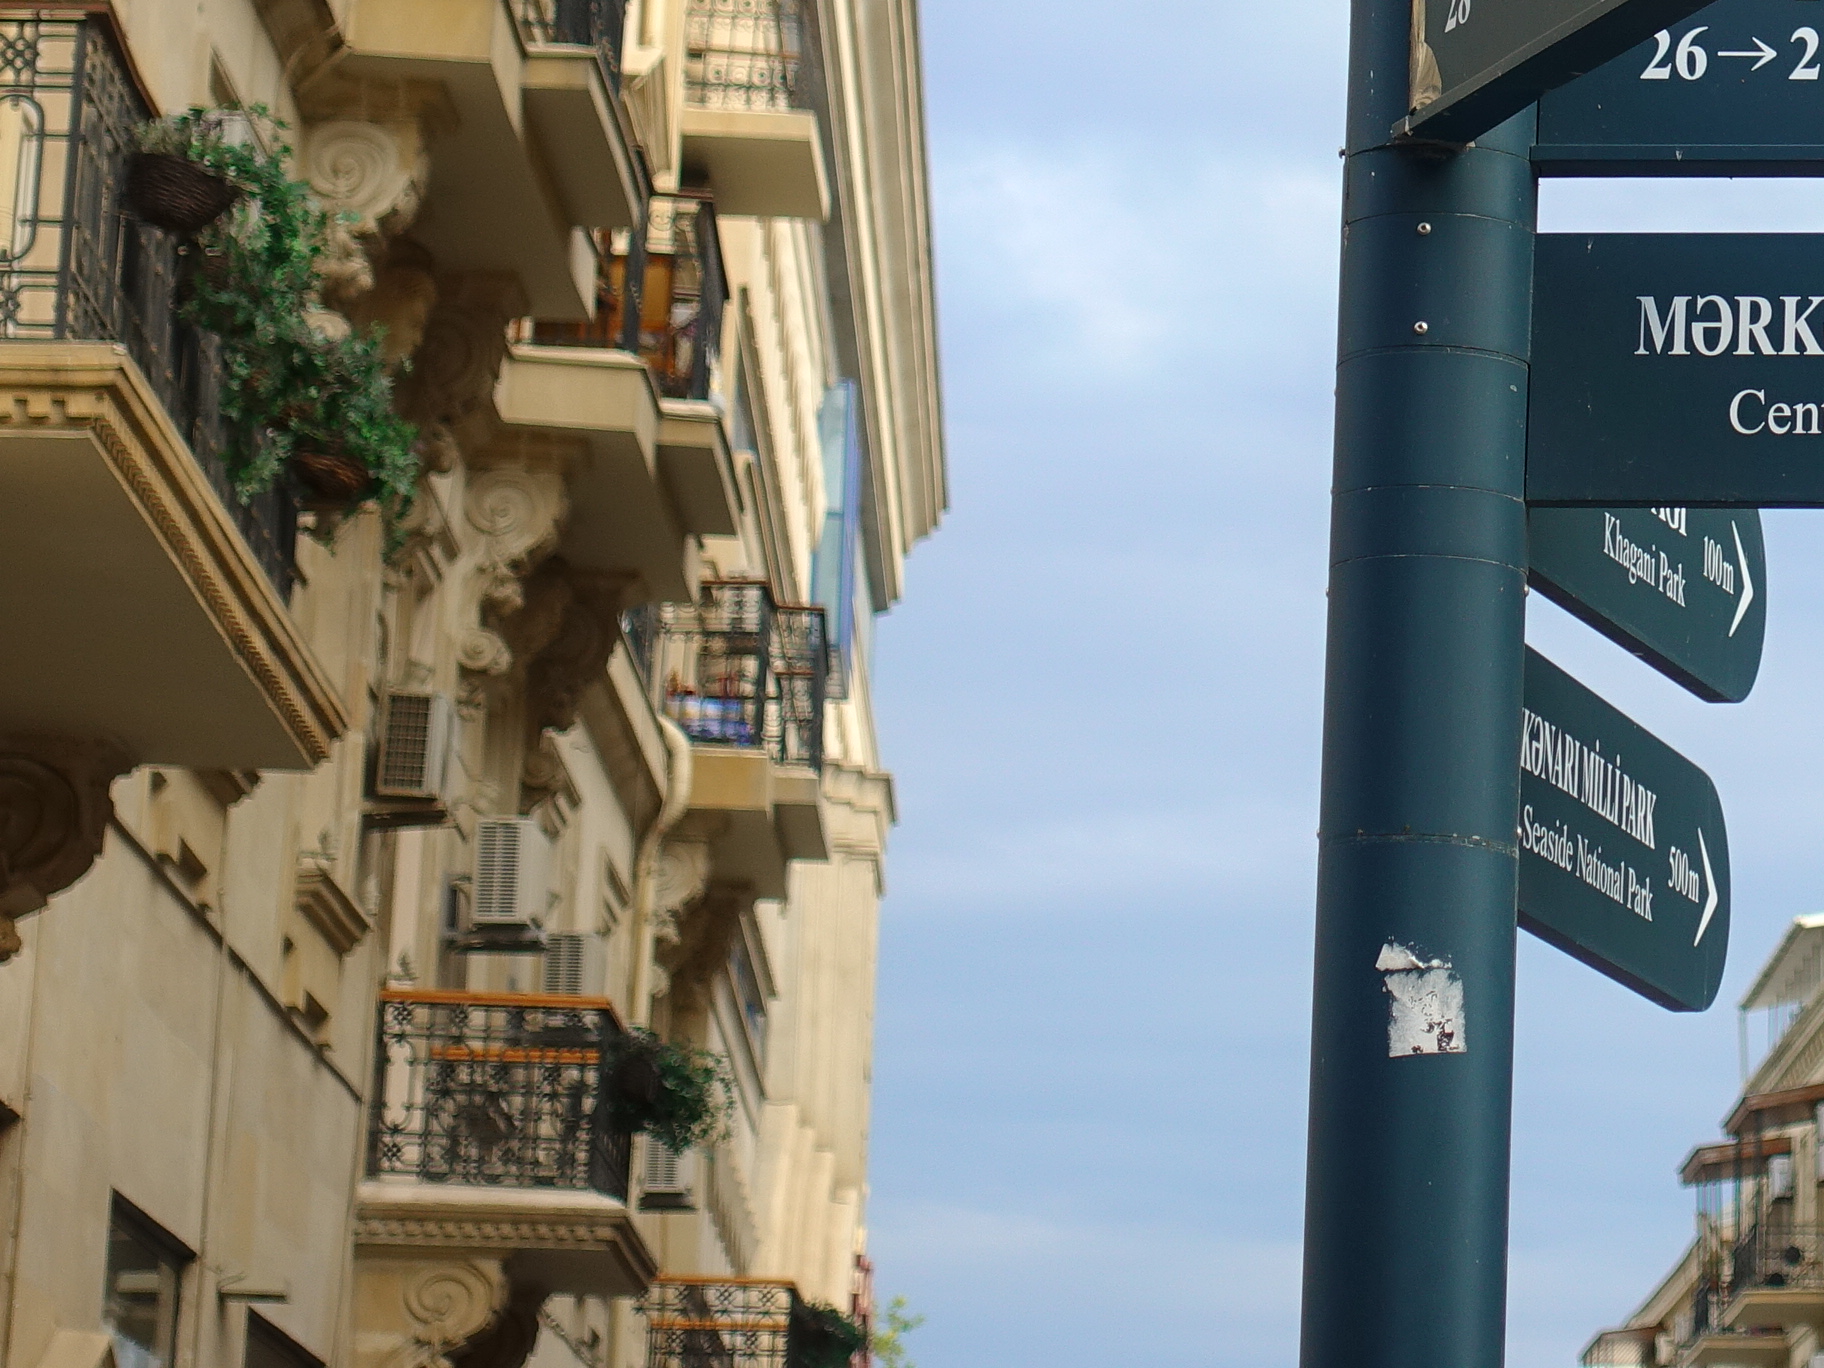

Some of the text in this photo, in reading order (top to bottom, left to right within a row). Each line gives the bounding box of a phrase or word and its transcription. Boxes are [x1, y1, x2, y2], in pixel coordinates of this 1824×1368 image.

[1639, 26, 1821, 81] 26 2
[1603, 511, 1656, 585] Khagani
[1658, 550, 1687, 609] Park
[1702, 535, 1735, 596] 100m
[1580, 738, 1632, 828] MİLLİ
[1621, 772, 1658, 851] PARK
[1522, 804, 1655, 923] Seaside National Park
[1667, 844, 1700, 905] 500m
